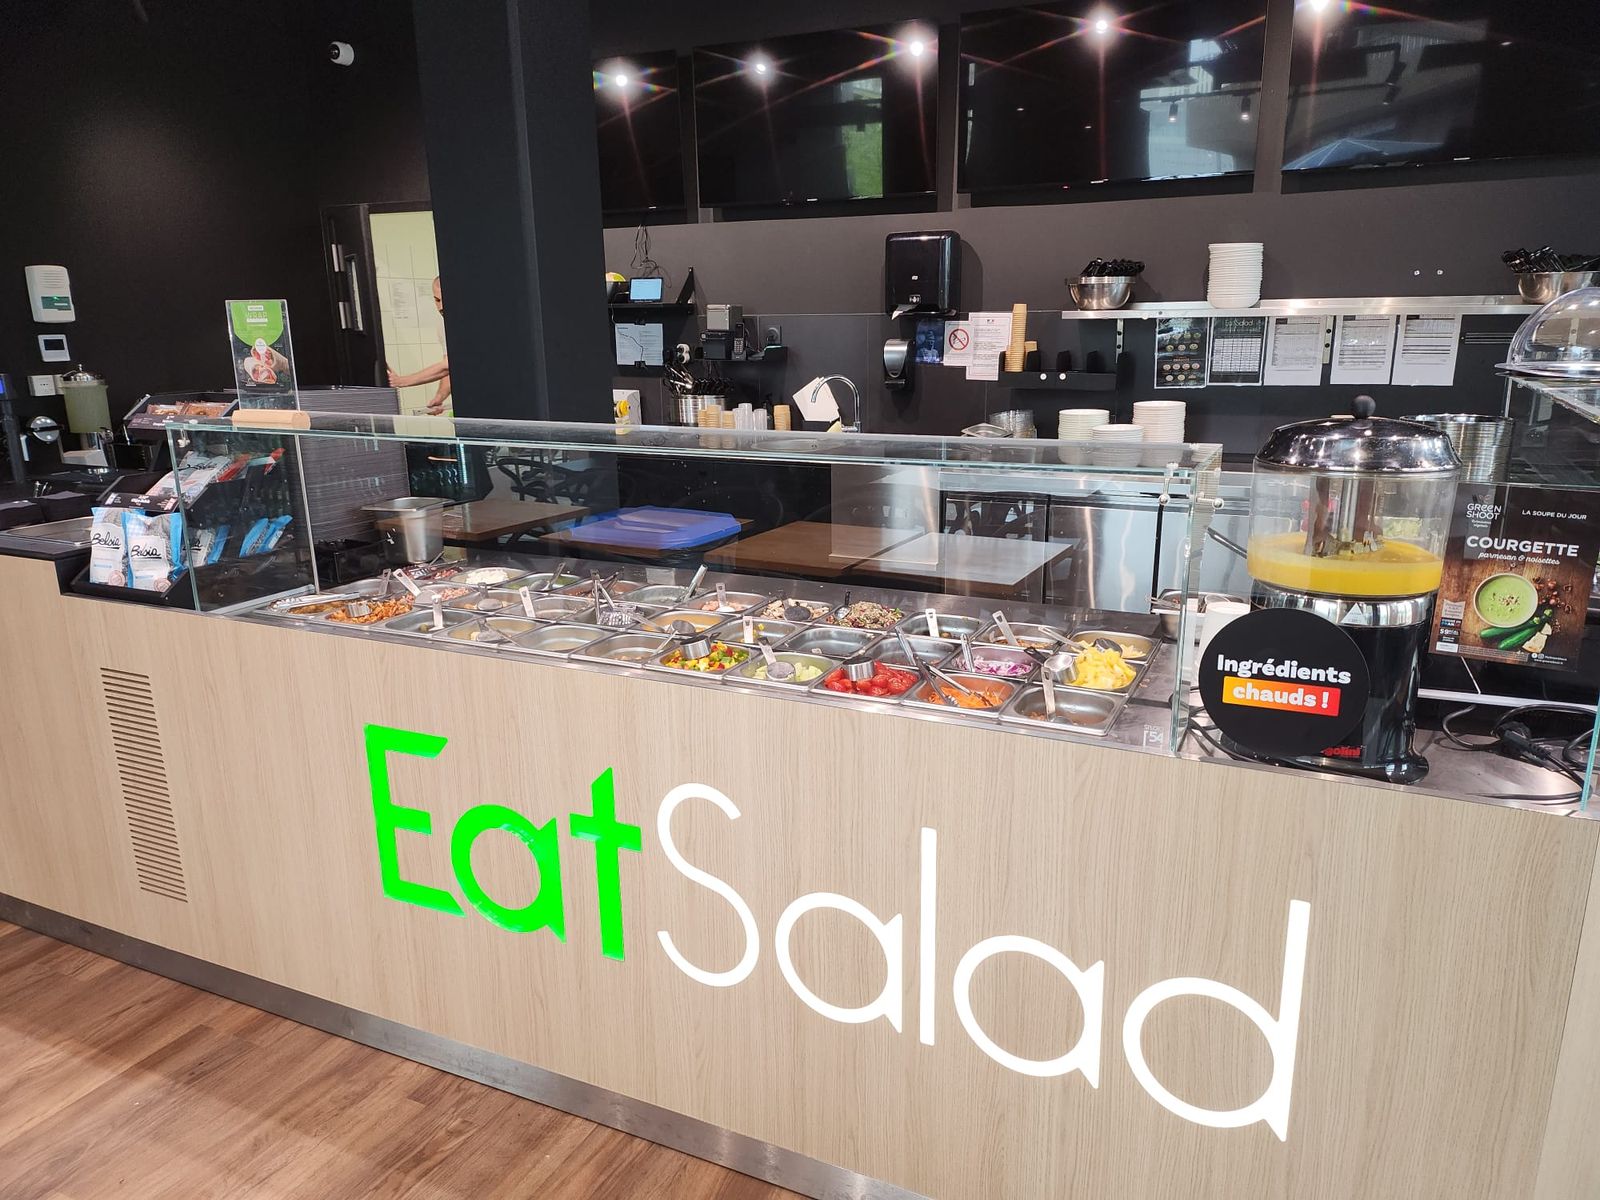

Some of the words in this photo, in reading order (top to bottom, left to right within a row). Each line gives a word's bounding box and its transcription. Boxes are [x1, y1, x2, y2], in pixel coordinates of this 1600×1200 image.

[1465, 510, 1500, 520] SHOOT
[1532, 510, 1555, 518] SOUPE
[1466, 535, 1579, 557] COURGETTE
[1478, 552, 1517, 561] parmesan
[1526, 555, 1560, 565] noisettes
[1217, 654, 1352, 684] Ingrédients
[1233, 682, 1317, 708] chauds
